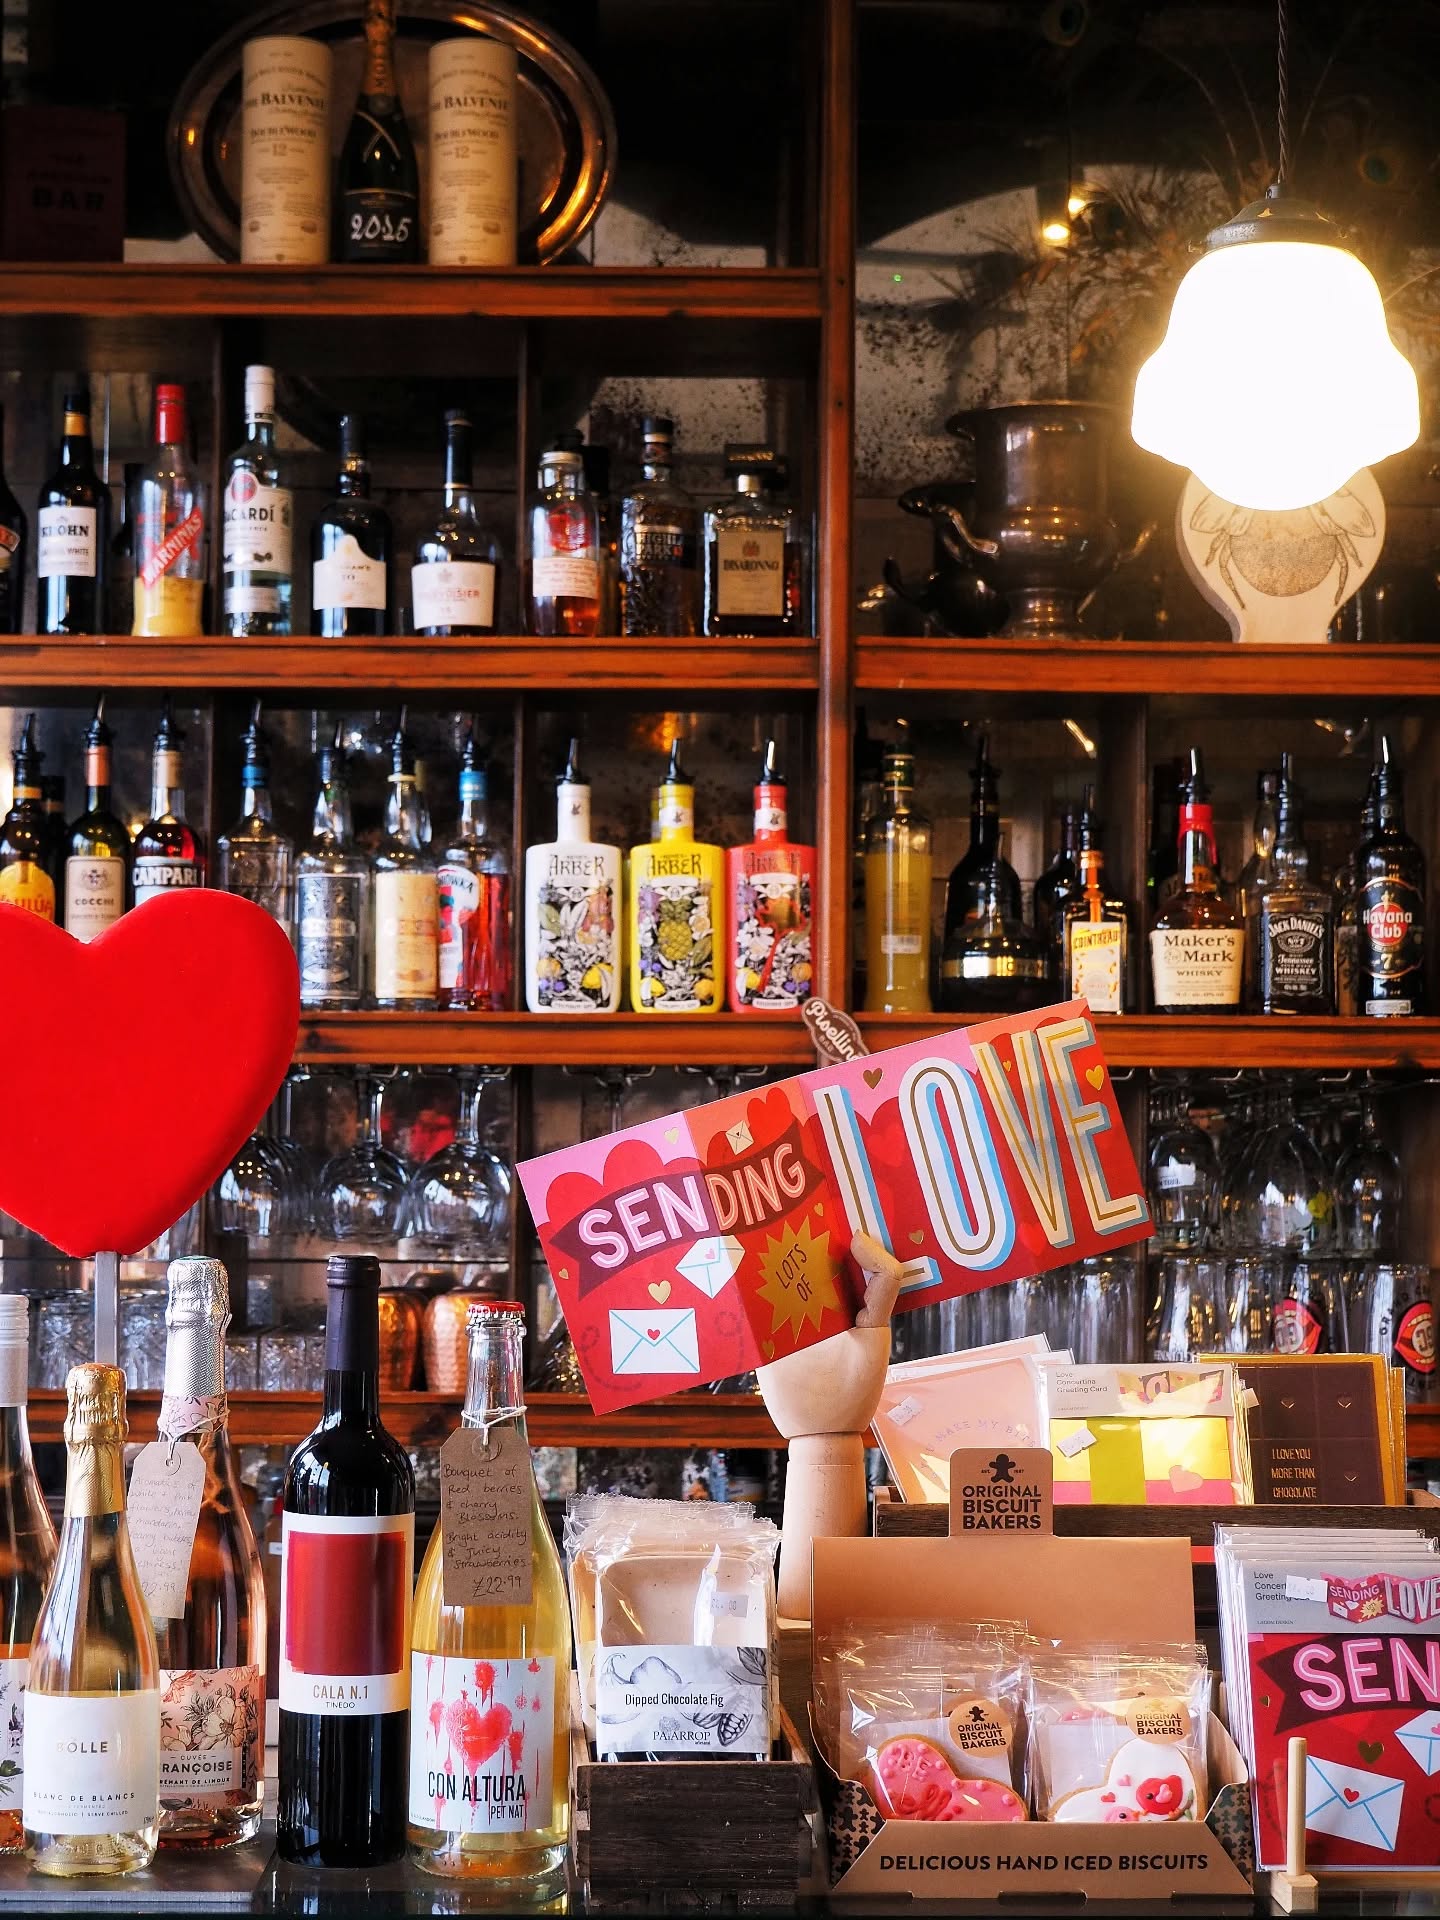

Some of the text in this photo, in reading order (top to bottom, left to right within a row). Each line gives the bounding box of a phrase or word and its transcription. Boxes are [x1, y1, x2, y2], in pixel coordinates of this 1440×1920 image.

[133, 866, 200, 887] CAMPARI
[1363, 908, 1413, 924] Havana
[1370, 923, 1402, 939] Club
[1164, 935, 1236, 947] Maker's
[1183, 950, 1234, 963] Mark
[1176, 969, 1223, 977] WHISKY
[1275, 966, 1317, 975] WHISKEY
[578, 1017, 1151, 1295] SENDING LOVE
[775, 1242, 809, 1290] LOTS
[795, 1273, 814, 1303] OF
[1276, 1448, 1295, 1460] LOVE
[1295, 1448, 1311, 1460] YOU
[443, 1464, 517, 1478] Bouquet of
[1271, 1467, 1316, 1479] MORE THAN
[448, 1485, 471, 1497] Red
[962, 1485, 1042, 1498] ORIGINAL
[1272, 1486, 1317, 1498] CHOCOLATE
[962, 1498, 1042, 1514] BISCUIT
[962, 1514, 1042, 1530] BAKERS
[446, 1529, 528, 1548] Bright acidity
[1254, 1571, 1275, 1580] Love
[1329, 1585, 1380, 1602] SENDING
[313, 1684, 369, 1700] CALA N.1
[625, 1692, 724, 1708] Dipped Chocolate Fig
[957, 1721, 1002, 1733] ORIGINAL
[1136, 1720, 1183, 1728] BISCUIT
[959, 1729, 1004, 1742] BISCUIT
[1137, 1727, 1184, 1736] BAKERS
[961, 1737, 1007, 1750] BAKERS
[162, 1760, 233, 1775] RANÇOISE
[428, 1771, 527, 1802] CON ALTURA
[33, 1791, 64, 1802] BLANC
[92, 1792, 135, 1803] BLANCS
[490, 1804, 525, 1820] PET NAT
[879, 1853, 1209, 1871] DELICIOUS HAND ICED BISCUITS
